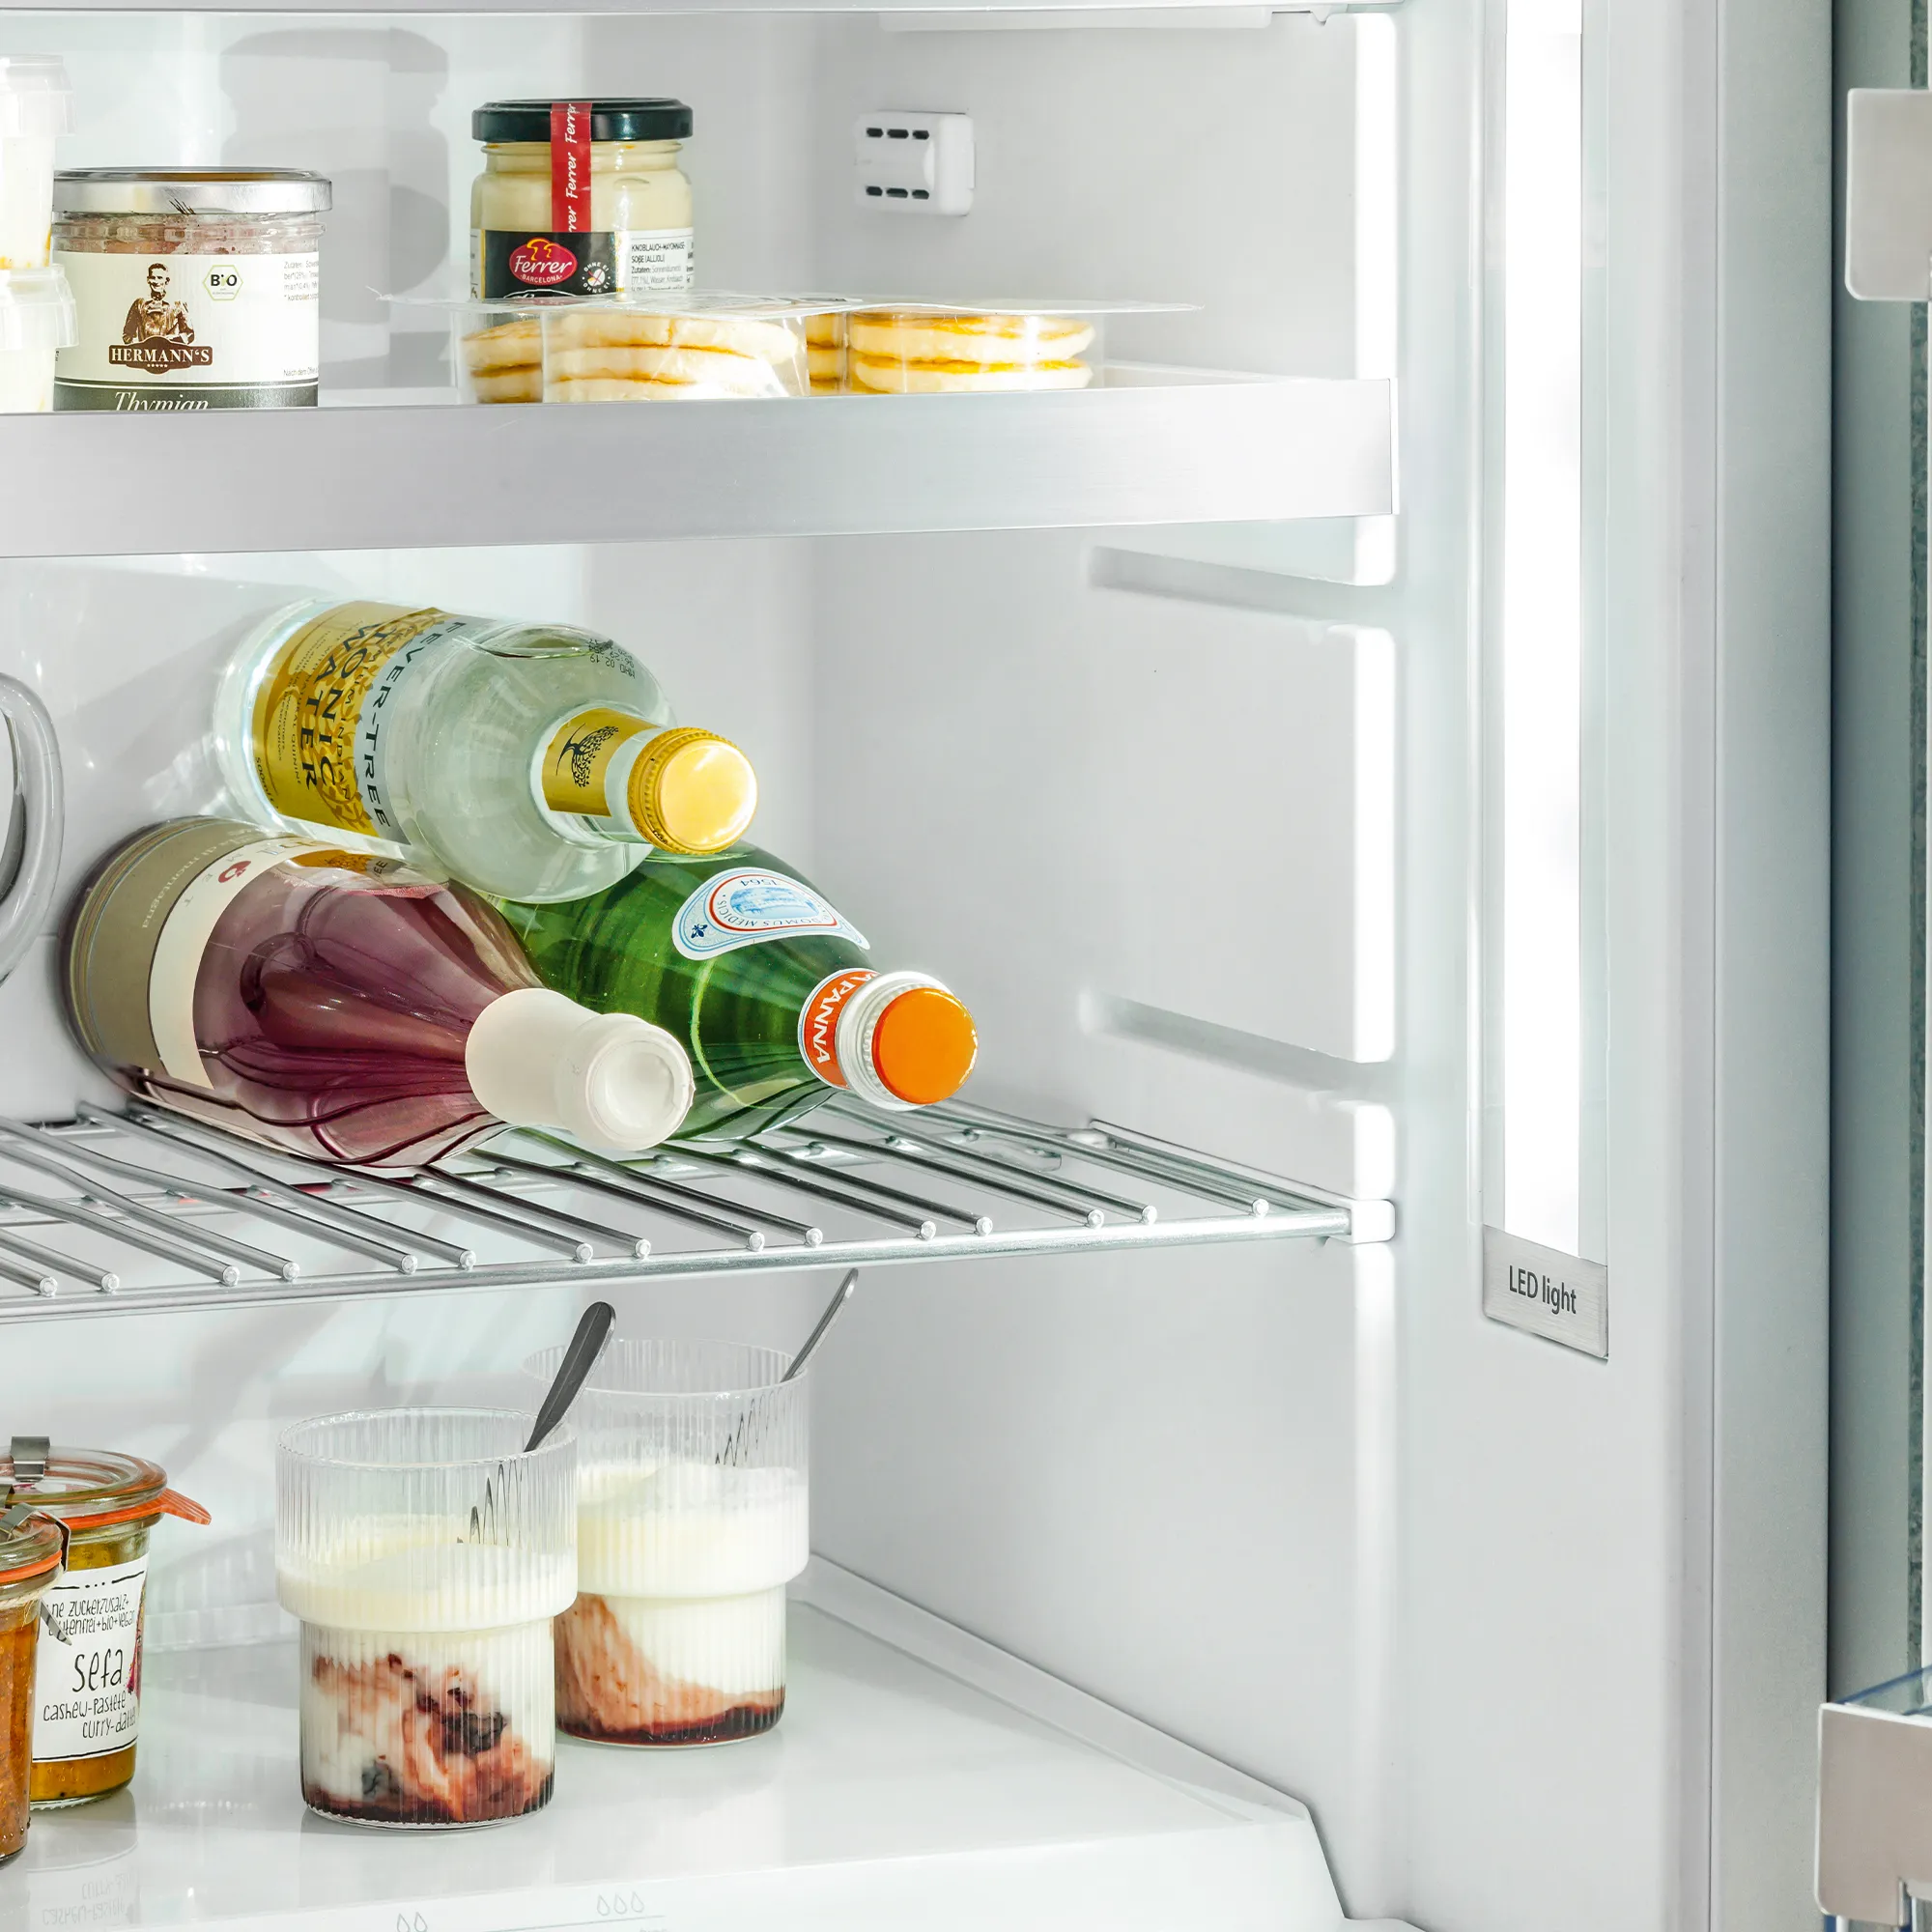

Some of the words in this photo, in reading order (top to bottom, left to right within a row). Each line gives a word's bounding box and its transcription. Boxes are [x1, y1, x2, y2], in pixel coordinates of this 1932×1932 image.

[564, 103, 578, 144] Ferrer
[565, 152, 579, 199] Ferrer
[514, 255, 573, 273] Ferrer
[583, 262, 601, 272] OHNE
[111, 349, 210, 363] HERMANN'S
[115, 391, 210, 411] Thymian
[299, 621, 385, 790] WATER
[318, 626, 398, 787] TONIC
[363, 621, 468, 828] FEVER-TREE
[291, 734, 301, 784] QUININE
[336, 717, 351, 800] INDIAN
[740, 877, 781, 888] 1564
[717, 899, 758, 927] MEDICIS
[812, 980, 857, 1065] PANNA
[1509, 1265, 1538, 1298] LED
[1542, 1275, 1577, 1315] light
